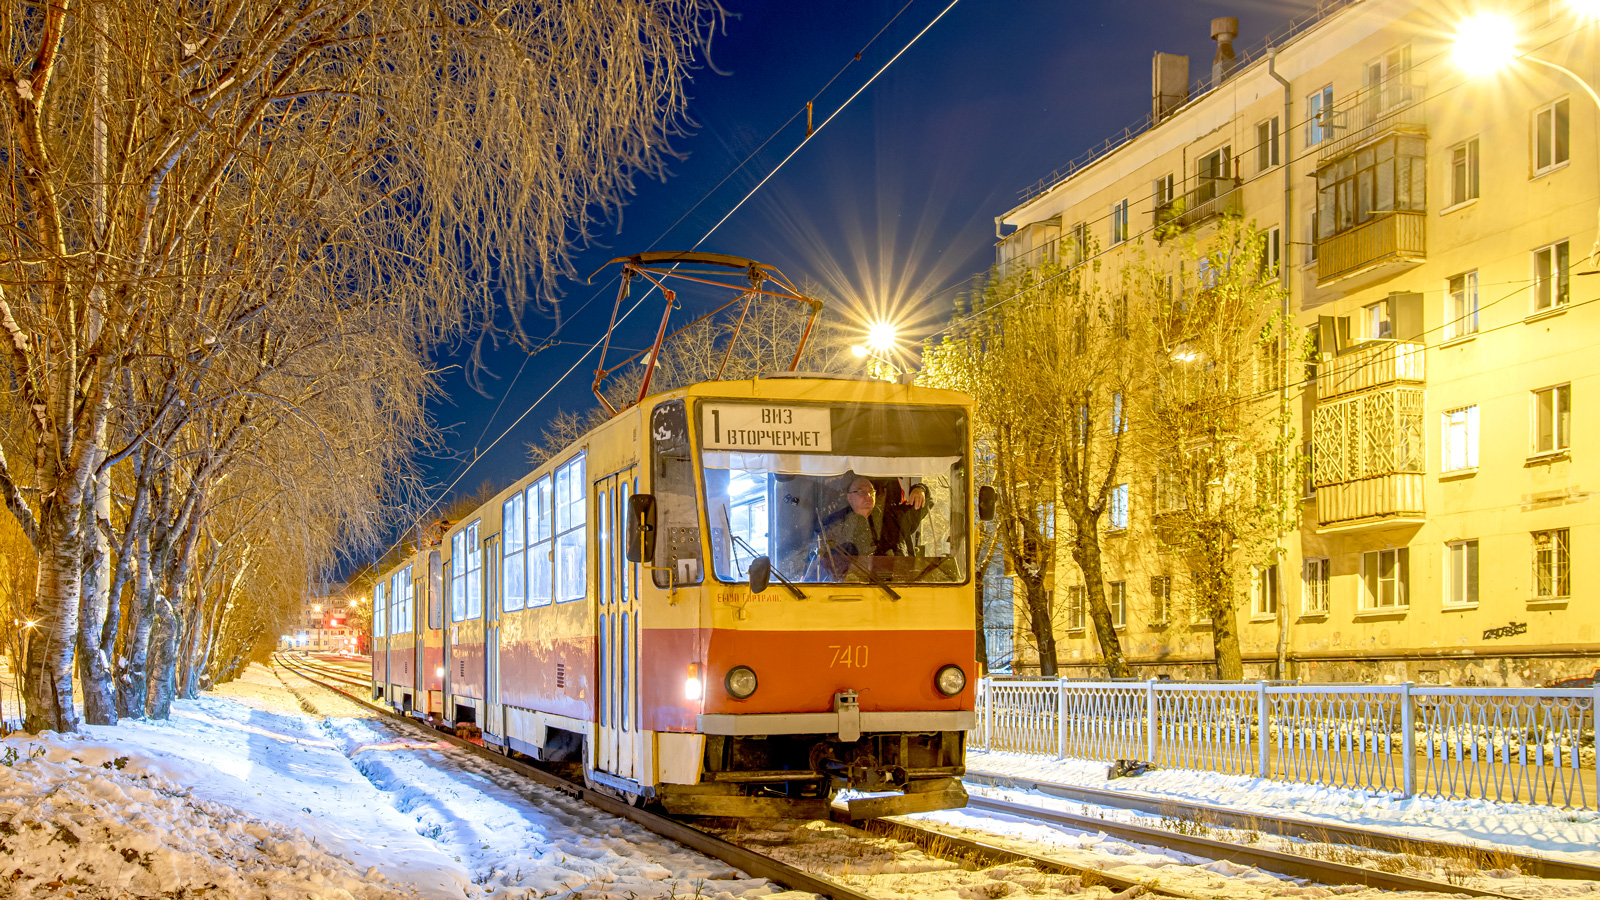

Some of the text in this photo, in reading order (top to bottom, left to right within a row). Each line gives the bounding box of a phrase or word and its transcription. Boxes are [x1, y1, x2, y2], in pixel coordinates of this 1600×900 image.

[711, 409, 720, 443] 1
[761, 408, 793, 424] ВИЗ
[727, 429, 820, 446] ВТОРЧЕРМЕТ
[828, 645, 868, 668] 740
